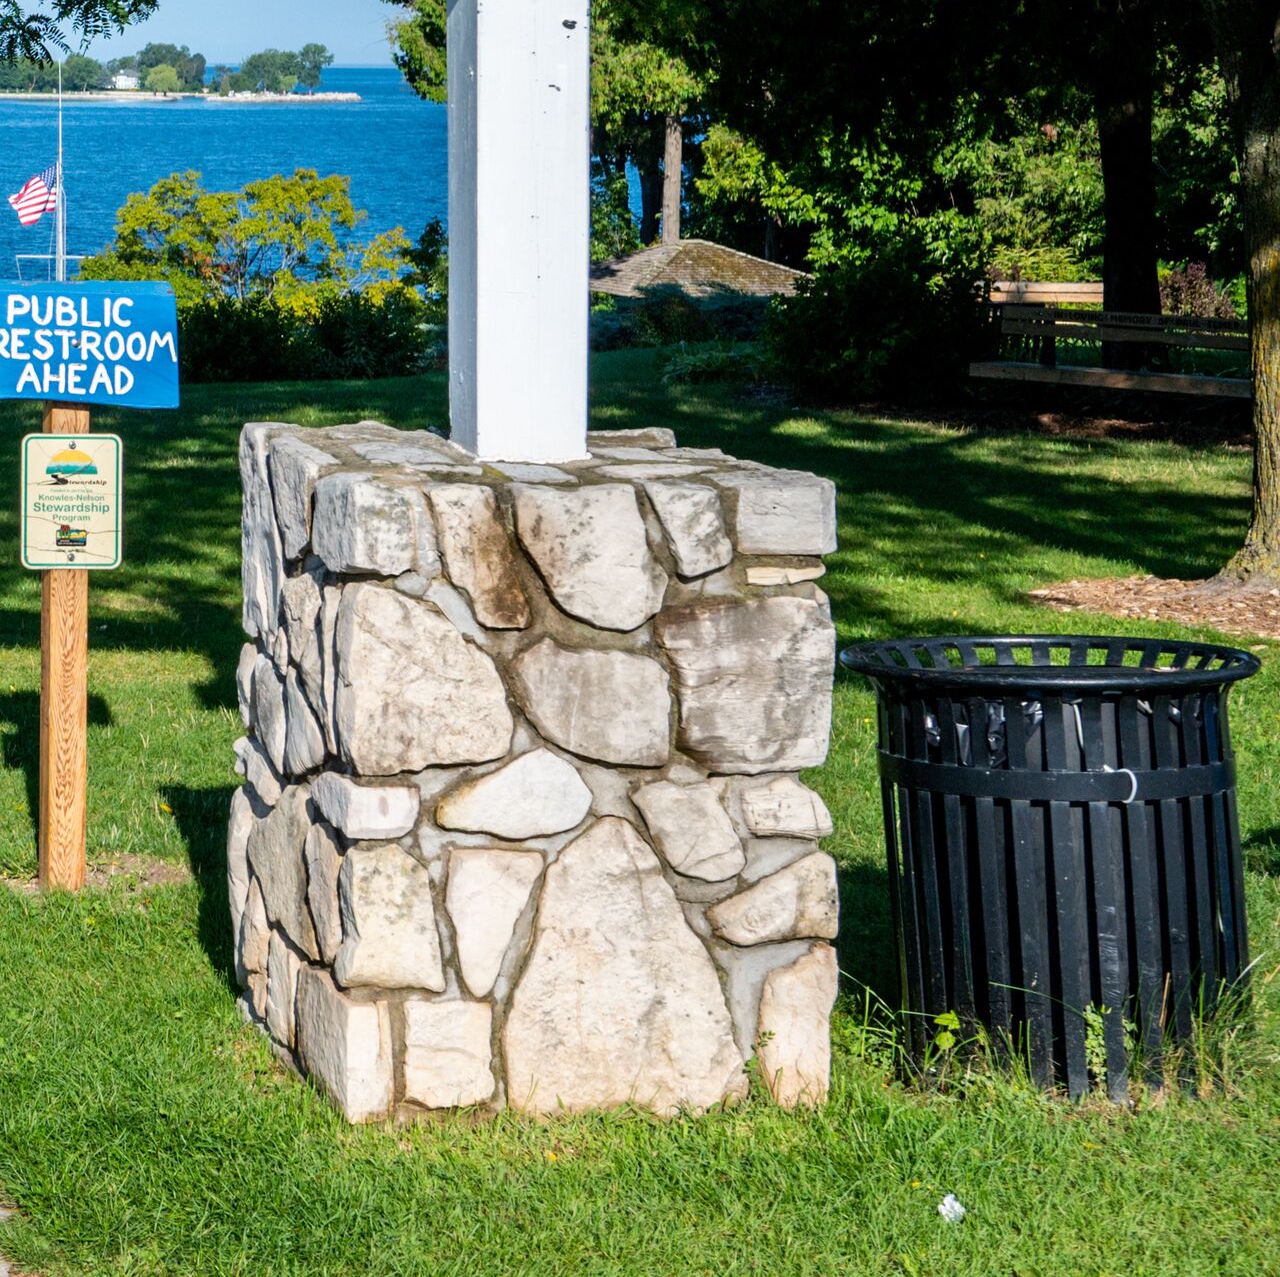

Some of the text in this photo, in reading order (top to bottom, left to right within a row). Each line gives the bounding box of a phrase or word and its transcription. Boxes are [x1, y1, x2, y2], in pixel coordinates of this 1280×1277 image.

[6, 294, 134, 328] PUBLIC
[16, 362, 135, 395] AHEAD
[38, 494, 105, 502] Knowles-Nelson
[33, 502, 110, 514] Stewardship
[52, 513, 91, 523] Program
